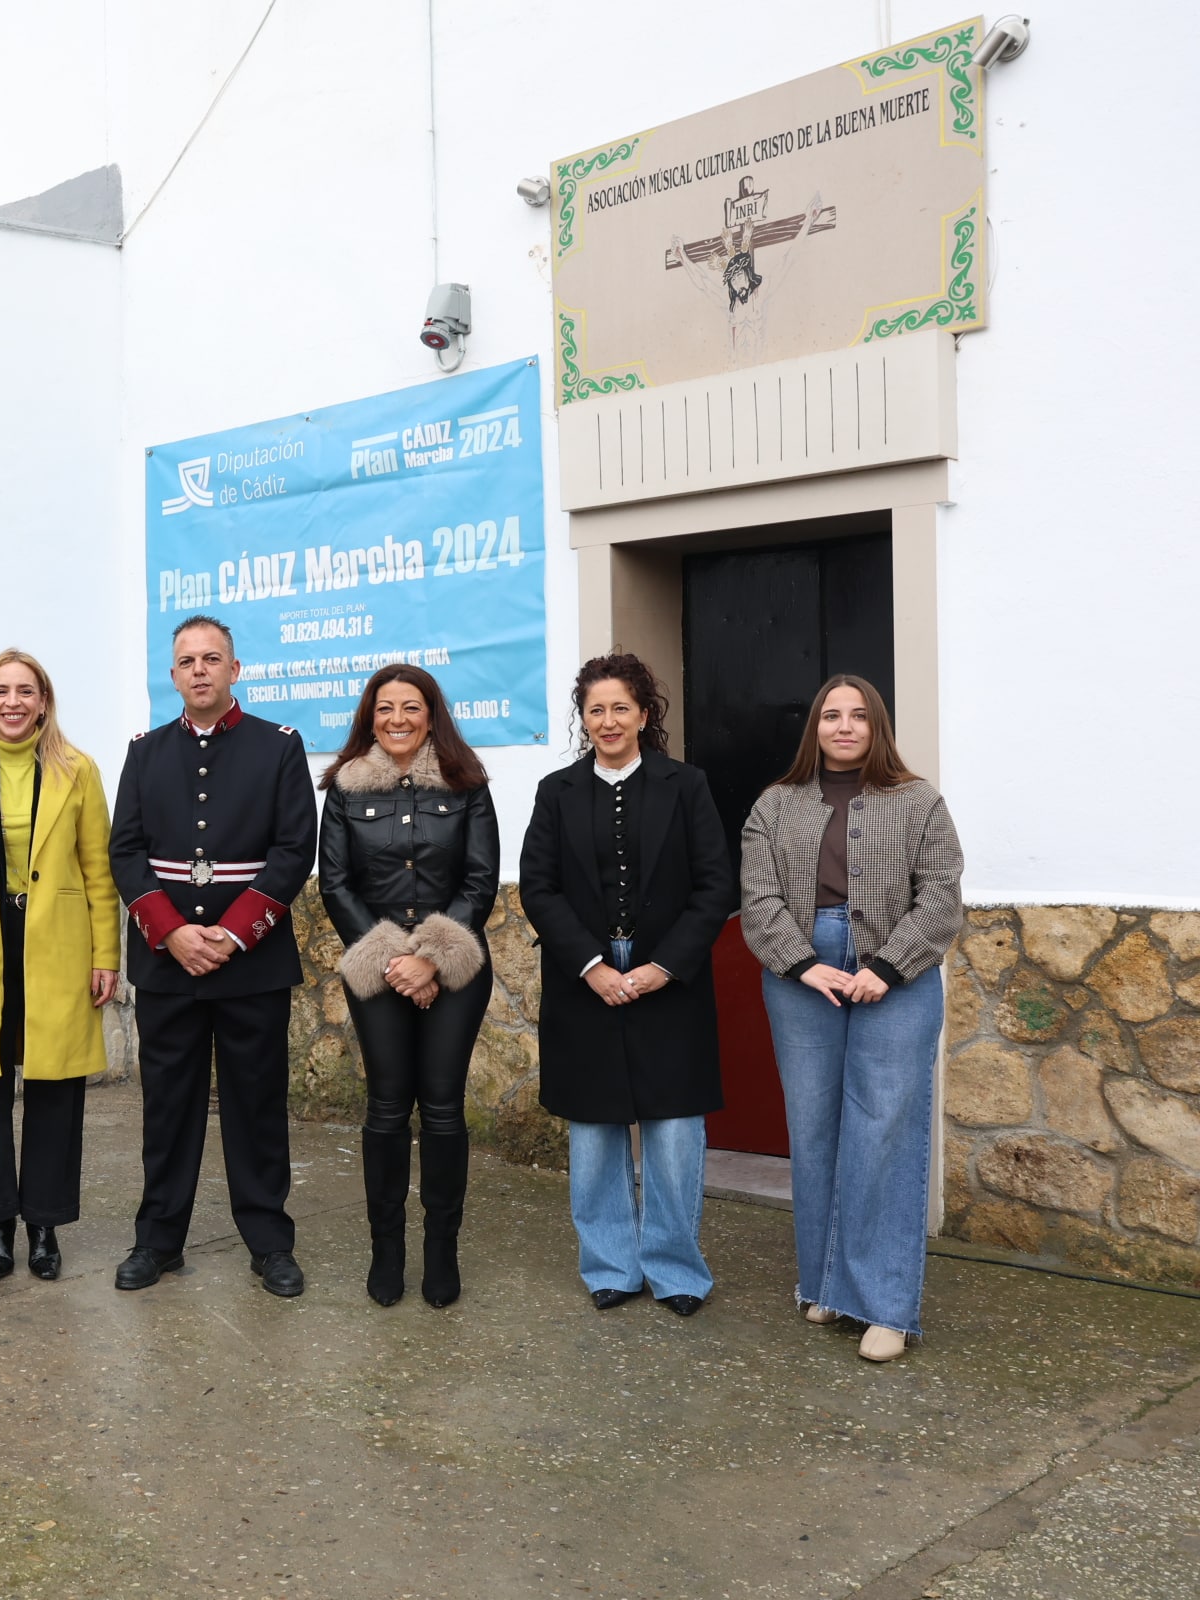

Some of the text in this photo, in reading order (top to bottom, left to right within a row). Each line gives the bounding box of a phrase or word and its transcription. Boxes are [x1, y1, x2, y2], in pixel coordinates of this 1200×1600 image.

[587, 87, 930, 214] ASOCIACIÓN MÚSICAL CULTURAL CRISTO DE LA BUENA MUERTE
[735, 200, 759, 220] INRI
[402, 420, 453, 451] CÁDIZ
[459, 417, 523, 459] 2024
[217, 439, 304, 476] Diputación
[351, 447, 399, 480] Plan
[404, 446, 453, 470] Marcha
[220, 475, 288, 505] de Cádiz
[159, 515, 525, 613] Plan CÁDIZ Marcha 2024
[279, 610, 309, 621] IMPORTE
[310, 607, 330, 618] TOTAL
[331, 605, 345, 616] DEL
[364, 615, 373, 636] €
[268, 662, 286, 679] DEL
[287, 659, 317, 678] LOCAL
[319, 656, 350, 676] PARA
[351, 649, 406, 673] CREACIÓN
[407, 650, 422, 667] DE
[423, 647, 451, 667] UNA
[247, 684, 289, 703] ESCUELA
[290, 680, 346, 700] MUNICIPAL
[348, 679, 362, 697] DE
[320, 699, 510, 729] Import 45.000 €
